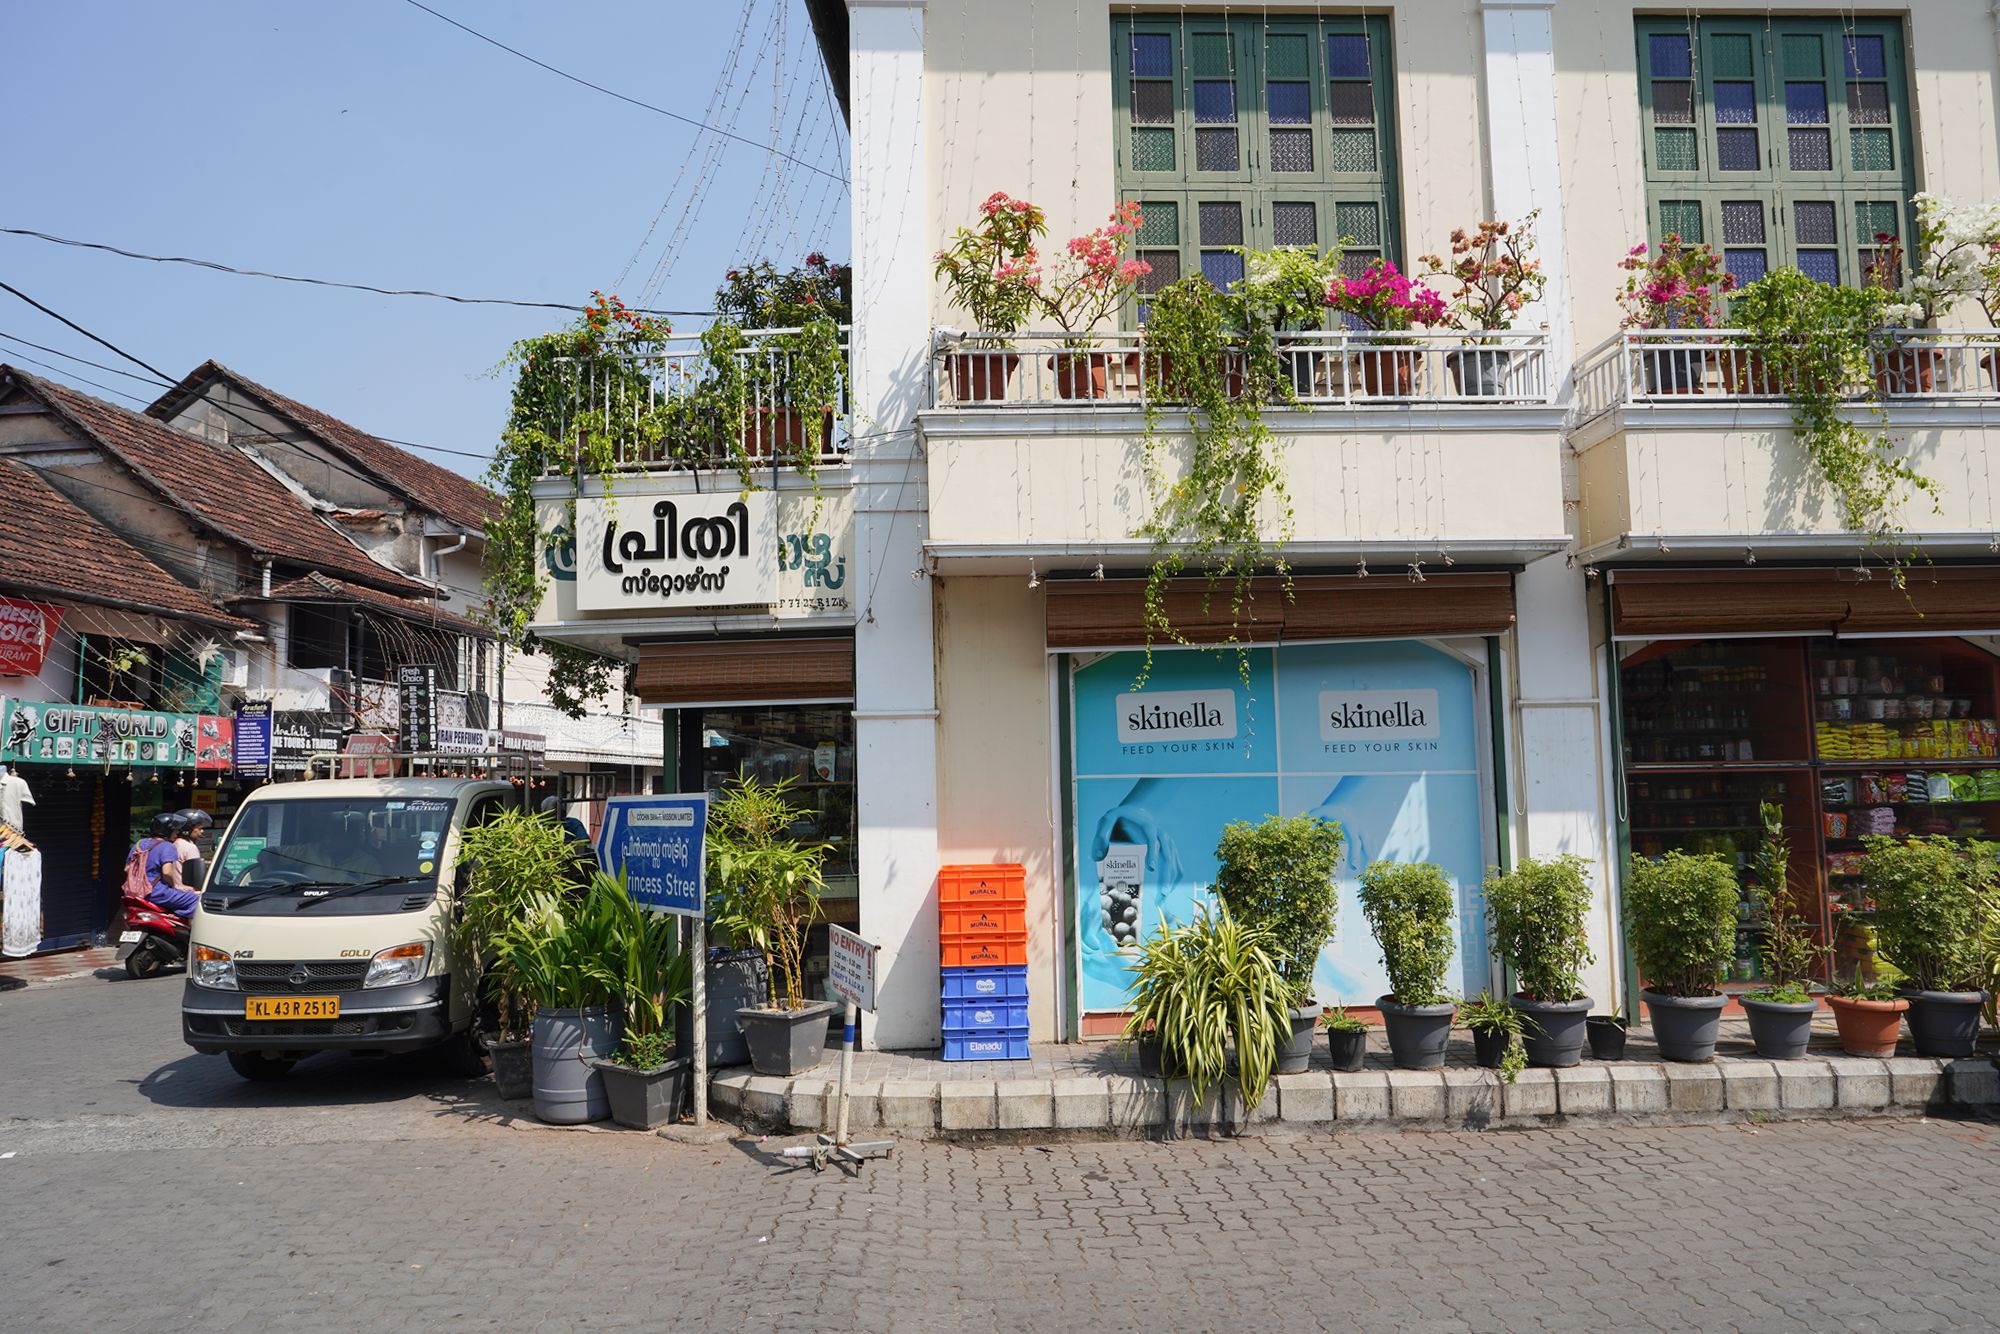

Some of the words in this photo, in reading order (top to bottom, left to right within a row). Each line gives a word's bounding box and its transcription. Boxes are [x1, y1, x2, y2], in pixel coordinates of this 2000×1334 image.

[602, 500, 749, 574] പ്രീതി
[0, 604, 43, 625] RESH
[401, 675, 425, 683] Choice
[428, 669, 437, 749] RESTAURANT
[1128, 701, 1224, 731] skinella
[1330, 701, 1427, 730] skinella
[44, 708, 96, 735] GIFT
[409, 685, 419, 751] RESTAURANT
[273, 724, 311, 737] Arafath
[454, 730, 483, 746] PERFUMES
[284, 737, 306, 749] TOURS
[311, 738, 338, 750] TRAVELS
[437, 744, 463, 754] EATHER
[1122, 744, 1154, 756] FEED
[1162, 742, 1200, 753] YOUR
[1205, 741, 1236, 752] SKIN
[1324, 743, 1357, 754] FEED
[1364, 742, 1401, 753] YOUR
[1407, 741, 1439, 752] SKIN
[1106, 859, 1137, 870] skinella
[627, 870, 662, 894] rincess
[969, 888, 998, 896] MURALYA
[970, 921, 999, 929] MURALYA
[829, 929, 840, 946] NO
[839, 934, 867, 960] ENTRY
[233, 950, 255, 958] ACE
[340, 949, 371, 957] GOLD
[970, 953, 999, 961] MURALYA
[255, 1002, 270, 1016] KL
[274, 1002, 290, 1015] 43
[293, 1001, 301, 1015] R
[303, 1001, 337, 1015] 2513
